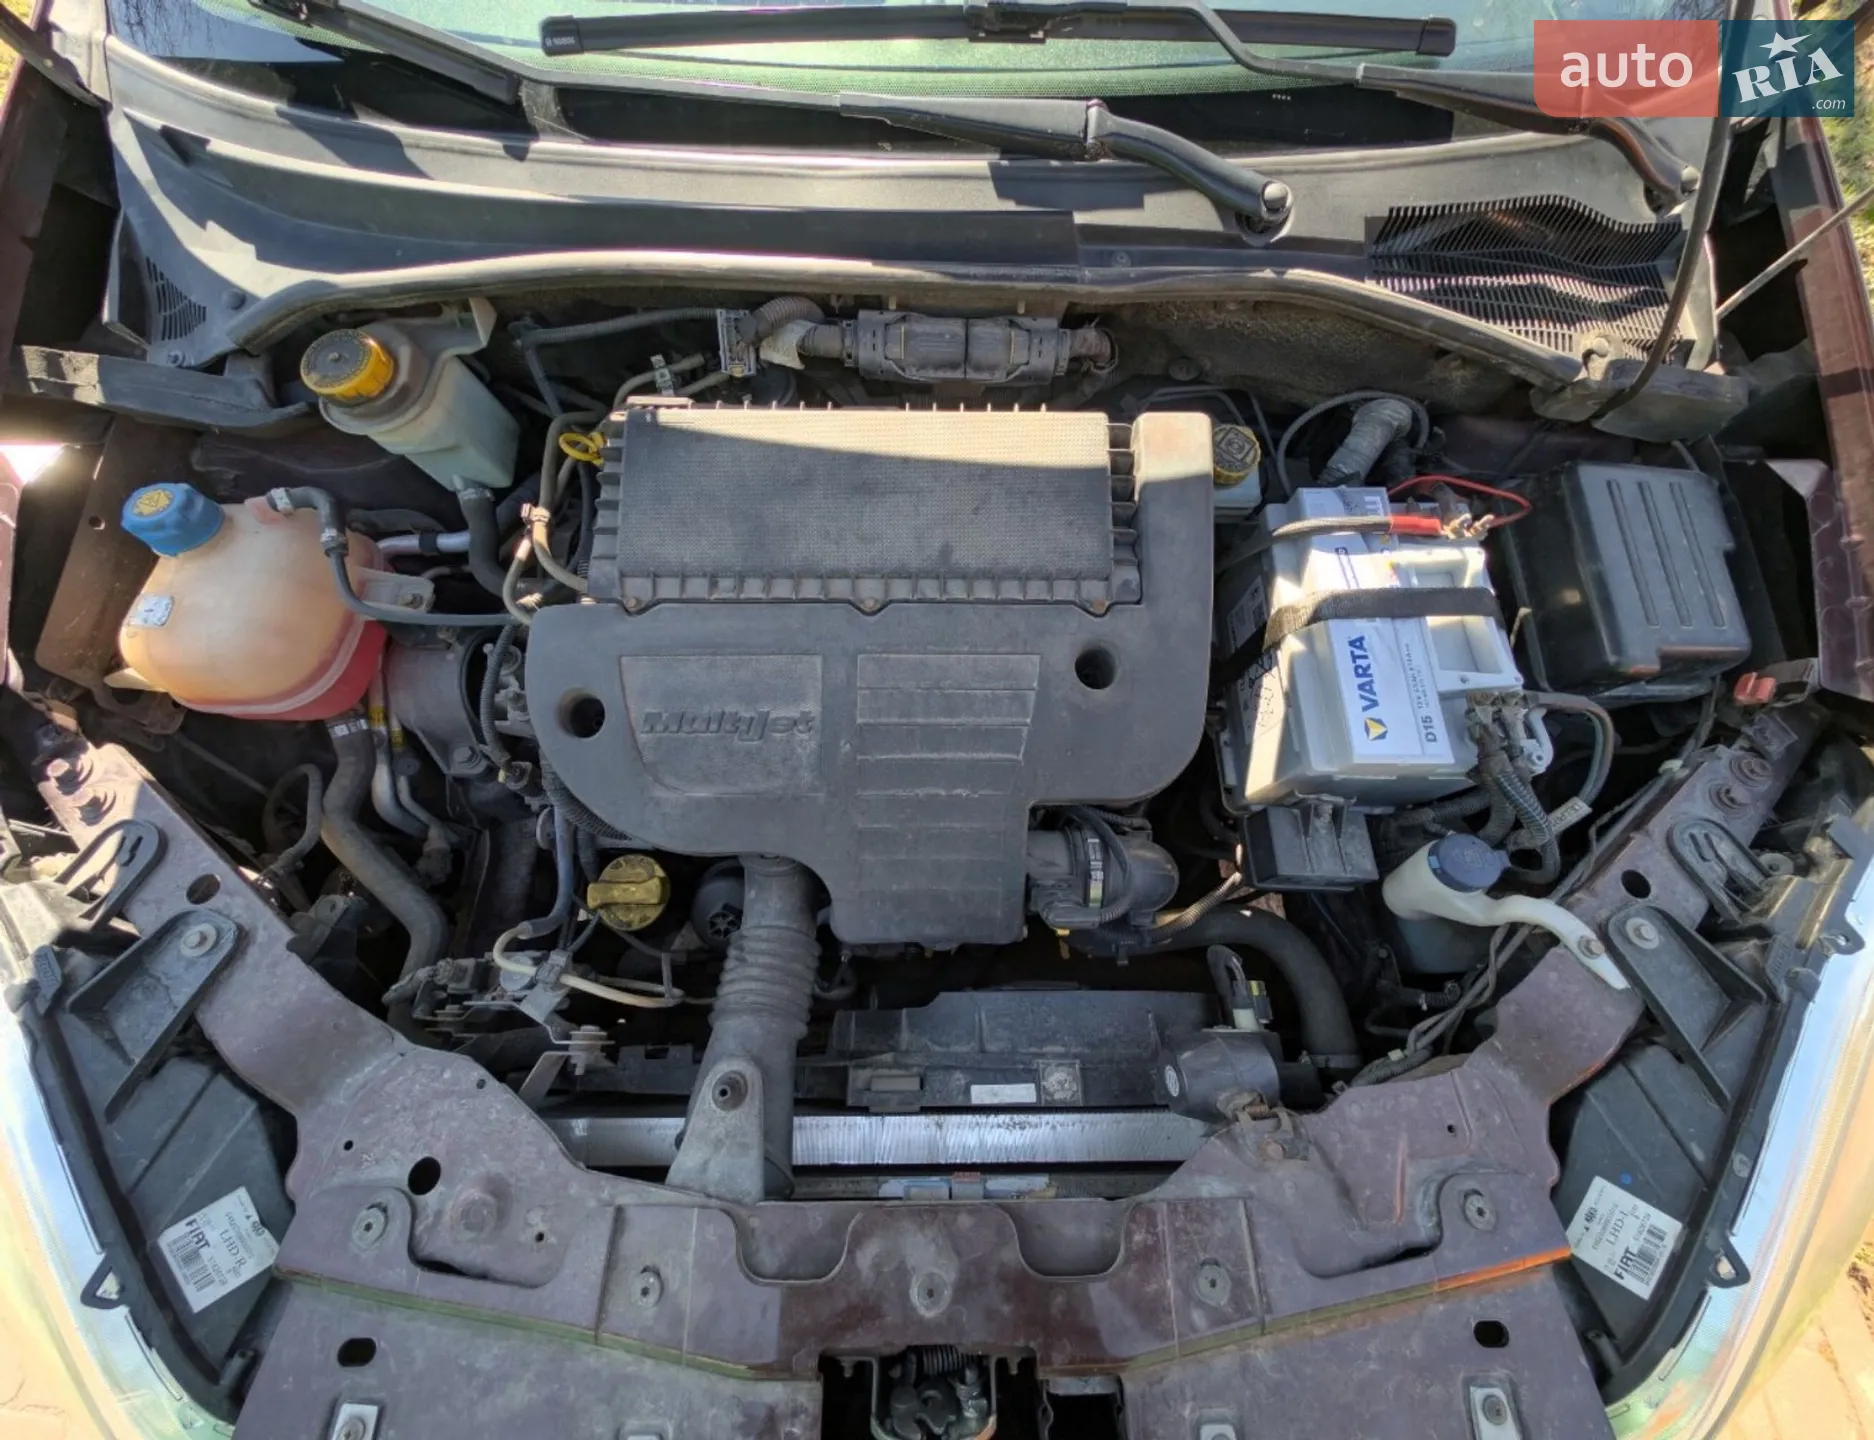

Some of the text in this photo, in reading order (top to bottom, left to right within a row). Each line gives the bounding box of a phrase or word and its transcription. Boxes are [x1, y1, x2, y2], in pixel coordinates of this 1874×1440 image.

[1347, 635, 1380, 712] VARTA
[1421, 715, 1438, 742] D15
[184, 1217, 211, 1250] FIAT
[1613, 1245, 1637, 1280] FIAT
